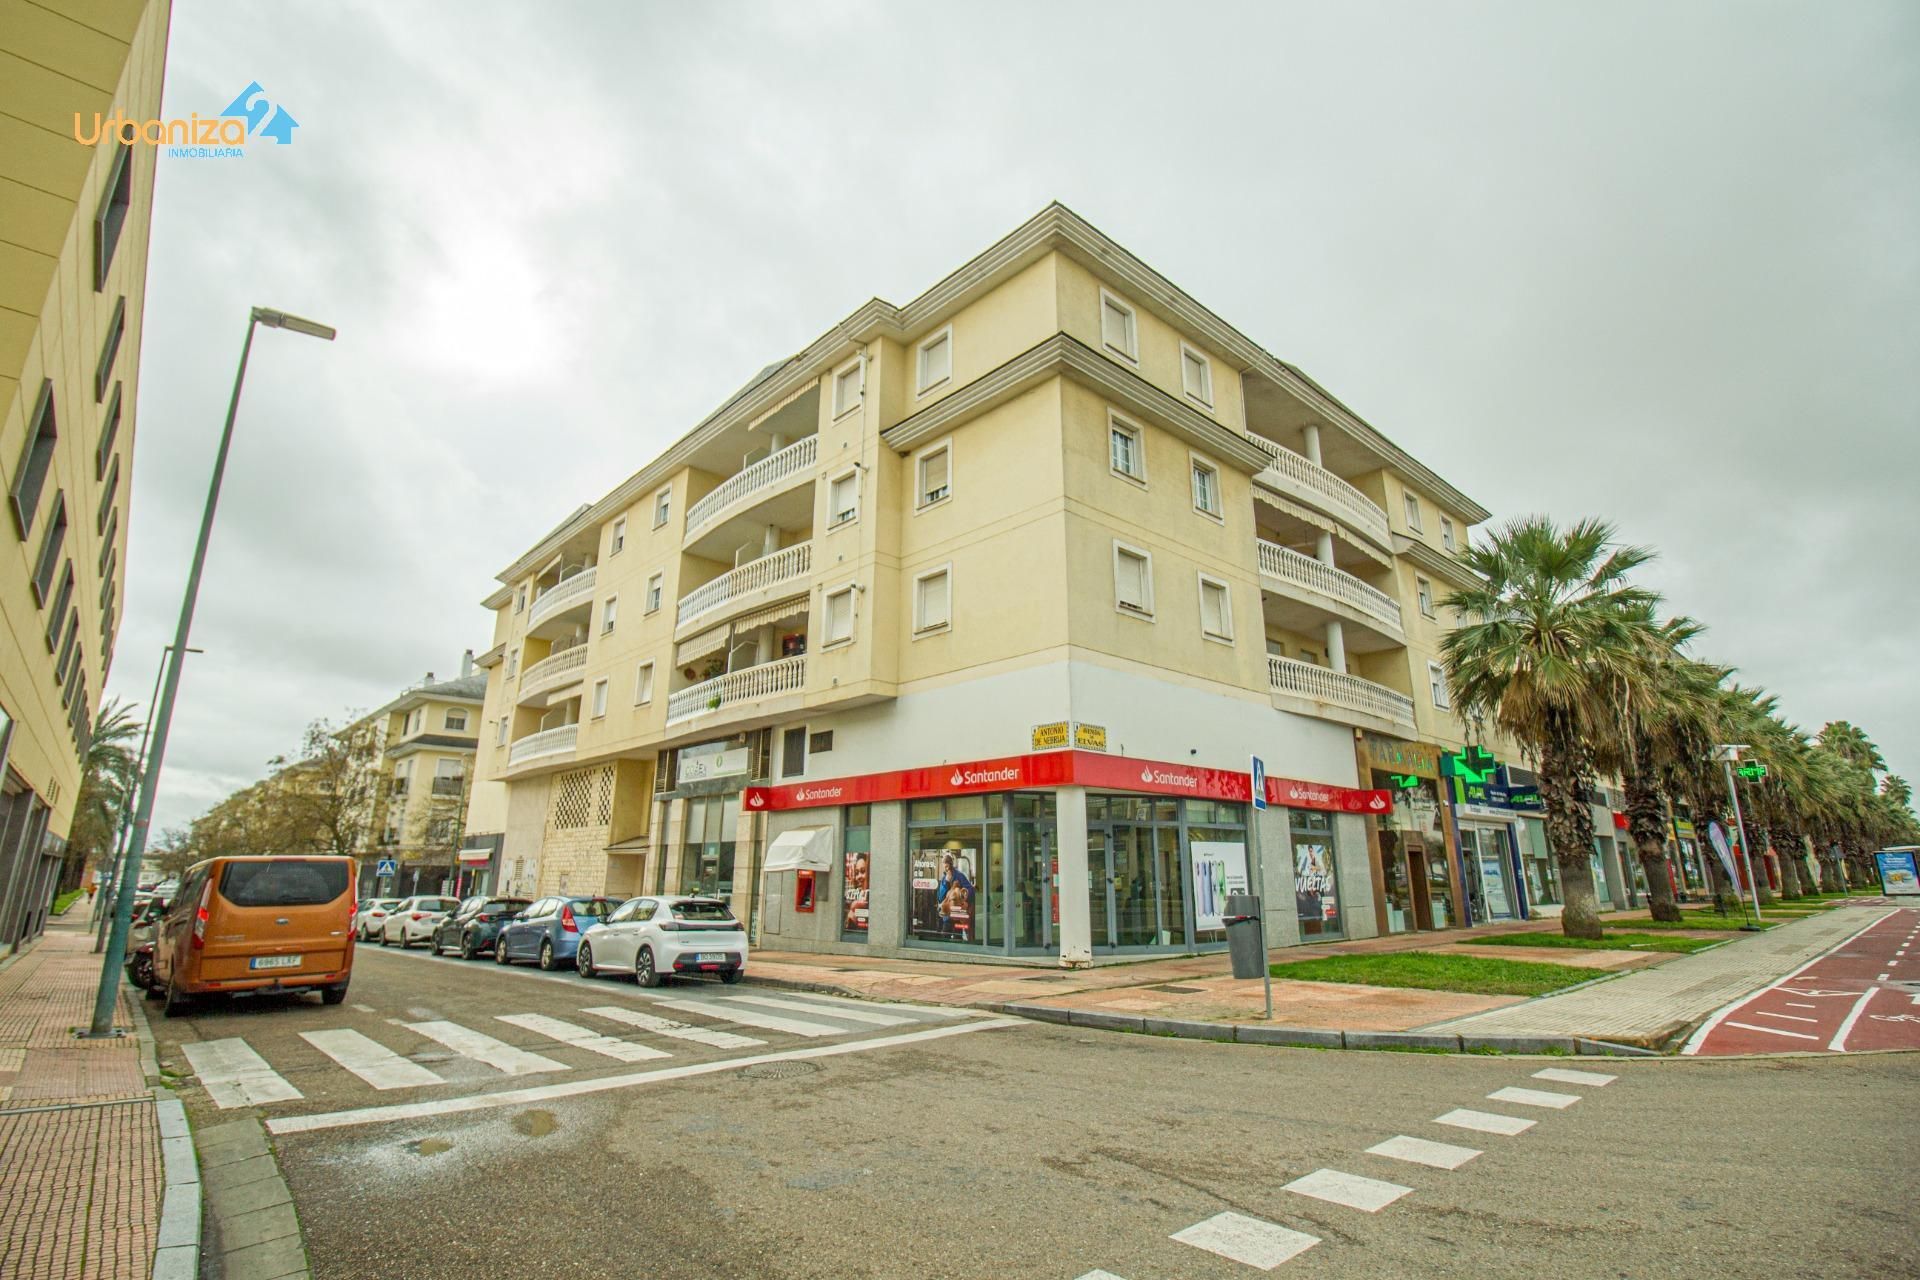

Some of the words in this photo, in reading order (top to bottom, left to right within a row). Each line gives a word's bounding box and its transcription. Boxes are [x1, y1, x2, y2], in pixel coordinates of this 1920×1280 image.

[1040, 726, 1064, 736] ANTONIO
[1043, 735, 1066, 745] NEBRIJA
[1078, 738, 1104, 747] ELVAS
[963, 767, 1019, 785] Santander
[1154, 770, 1198, 788] Santander
[805, 787, 842, 800] Santander
[1298, 789, 1329, 802] Santander
[1295, 876, 1331, 893] VUELTAS
